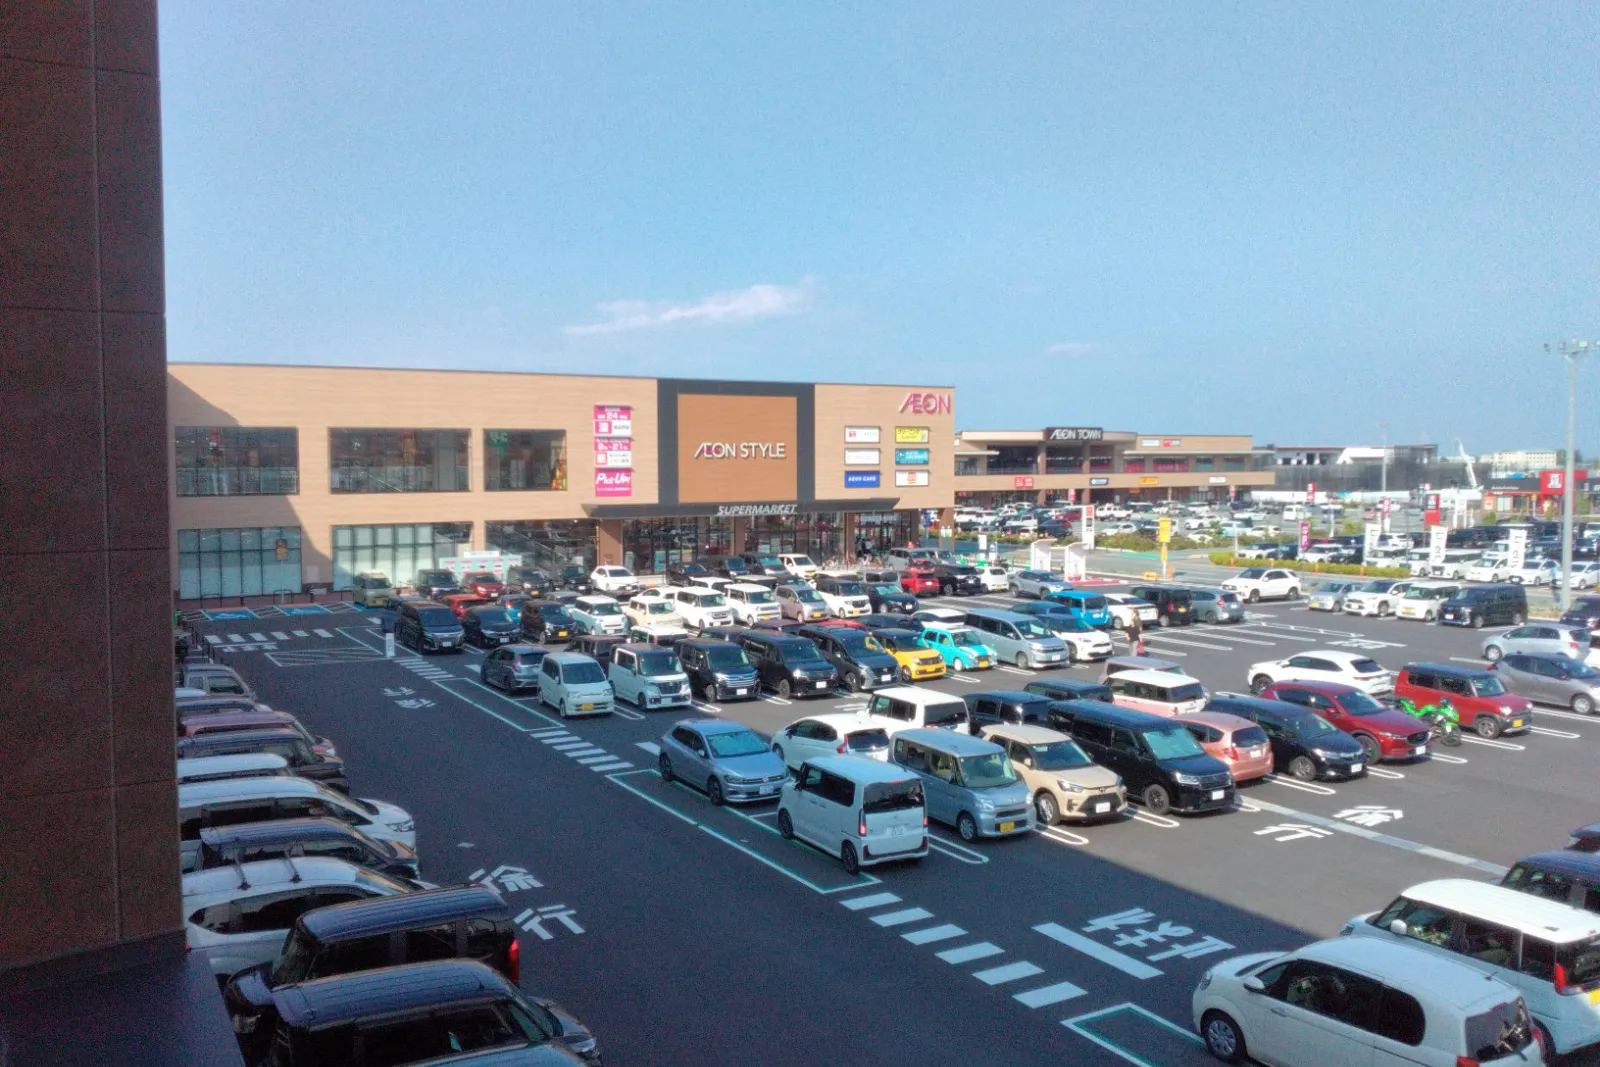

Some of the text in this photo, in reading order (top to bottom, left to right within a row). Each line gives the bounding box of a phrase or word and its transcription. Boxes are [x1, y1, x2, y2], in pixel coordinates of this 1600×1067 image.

[1077, 429, 1101, 439] TOWN
[740, 442, 785, 458] STYLE
[716, 504, 798, 516] SUPERMARKET
[1081, 907, 1237, 962] 止まれ
